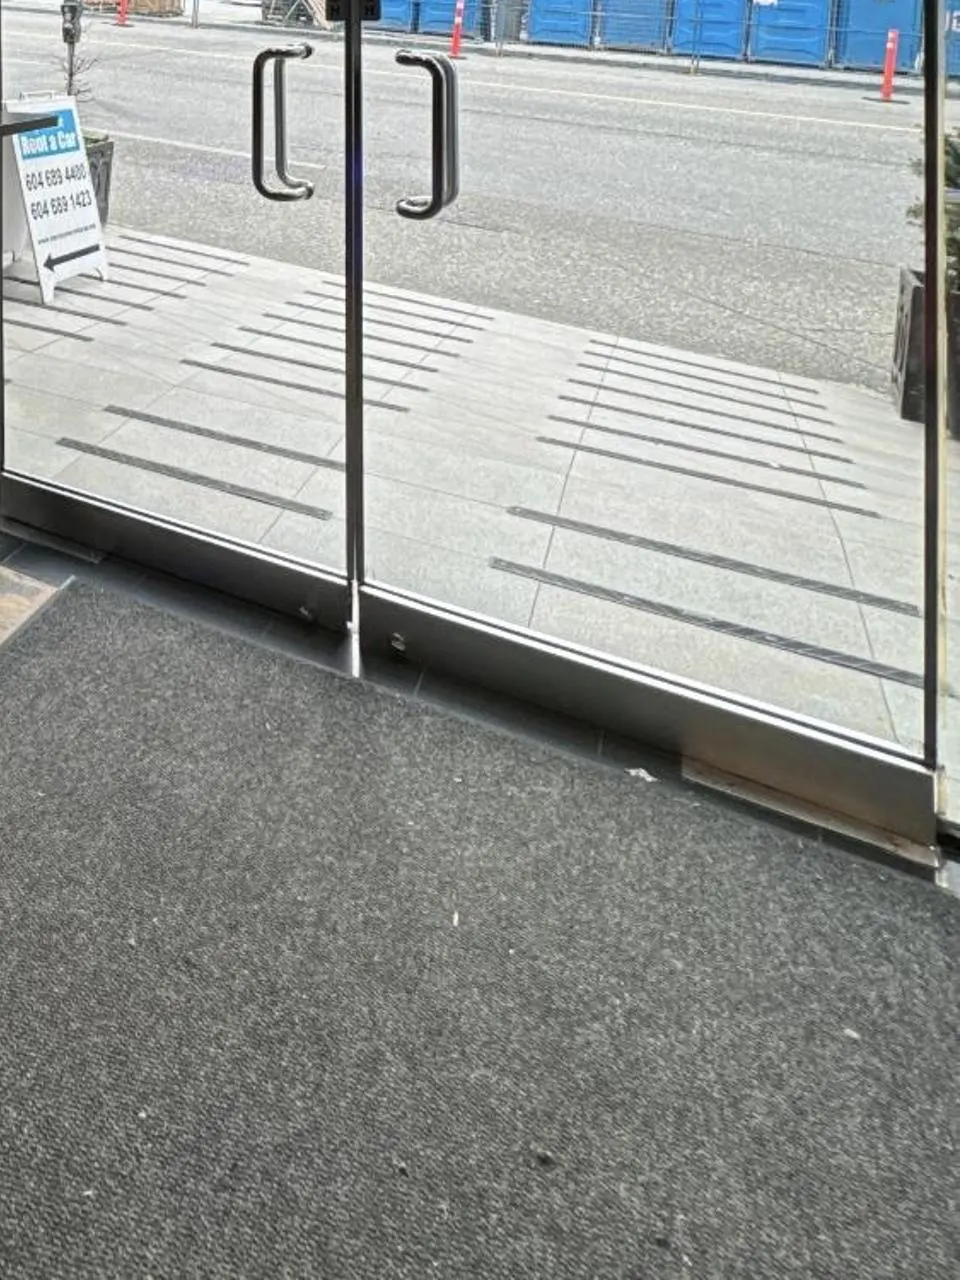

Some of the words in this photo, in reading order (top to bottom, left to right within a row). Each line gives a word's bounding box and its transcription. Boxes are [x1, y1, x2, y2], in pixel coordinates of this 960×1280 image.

[20, 135, 50, 155] Rent
[58, 130, 77, 150] Car
[25, 171, 45, 192] 604
[44, 167, 63, 188] 689
[30, 201, 50, 221] 604
[70, 189, 92, 209] 1423
